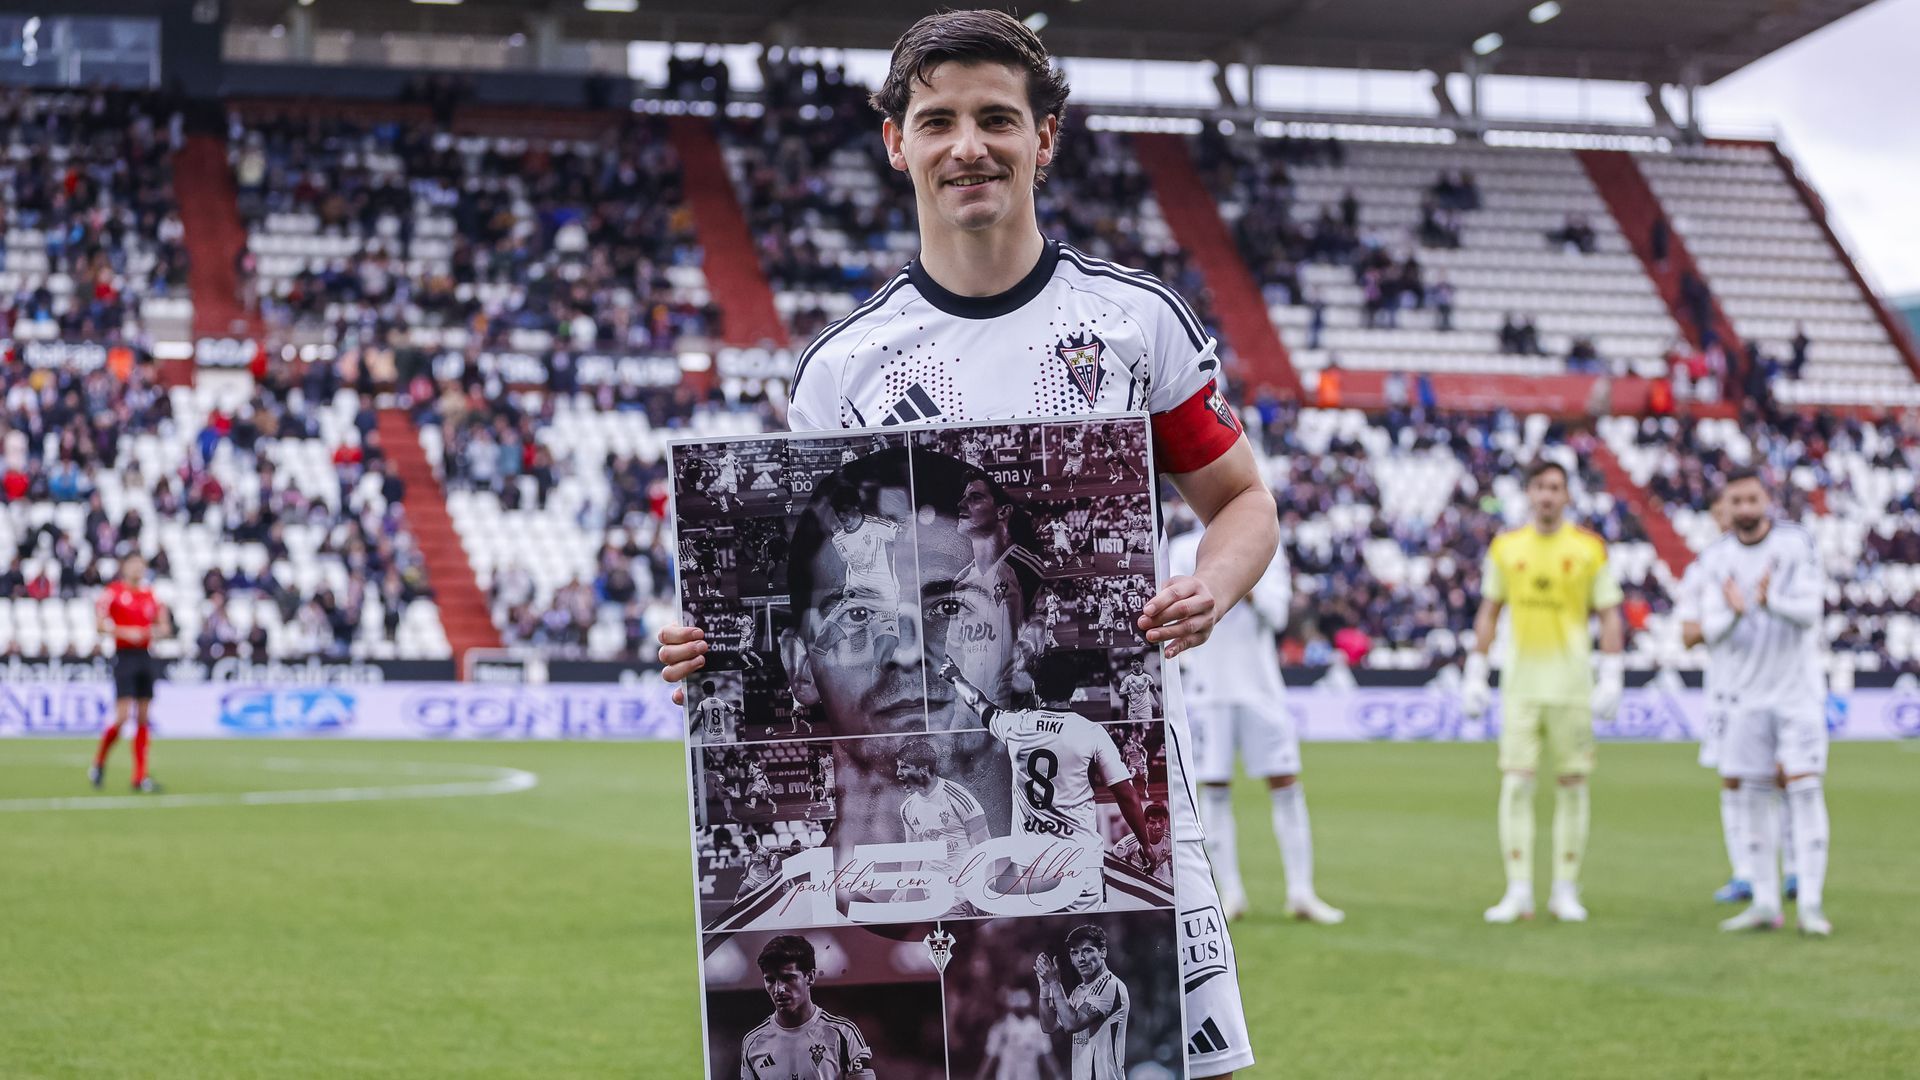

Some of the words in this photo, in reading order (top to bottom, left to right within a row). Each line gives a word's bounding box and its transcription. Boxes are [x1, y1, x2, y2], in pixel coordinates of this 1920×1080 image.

[1127, 595, 1142, 610] 20
[711, 707, 721, 726] 8
[1036, 719, 1065, 735] RIKI
[1024, 748, 1059, 811] 8
[778, 858, 882, 917] partidos
[895, 876, 932, 890] con
[947, 851, 987, 889] el
[982, 841, 1085, 907] Alba
